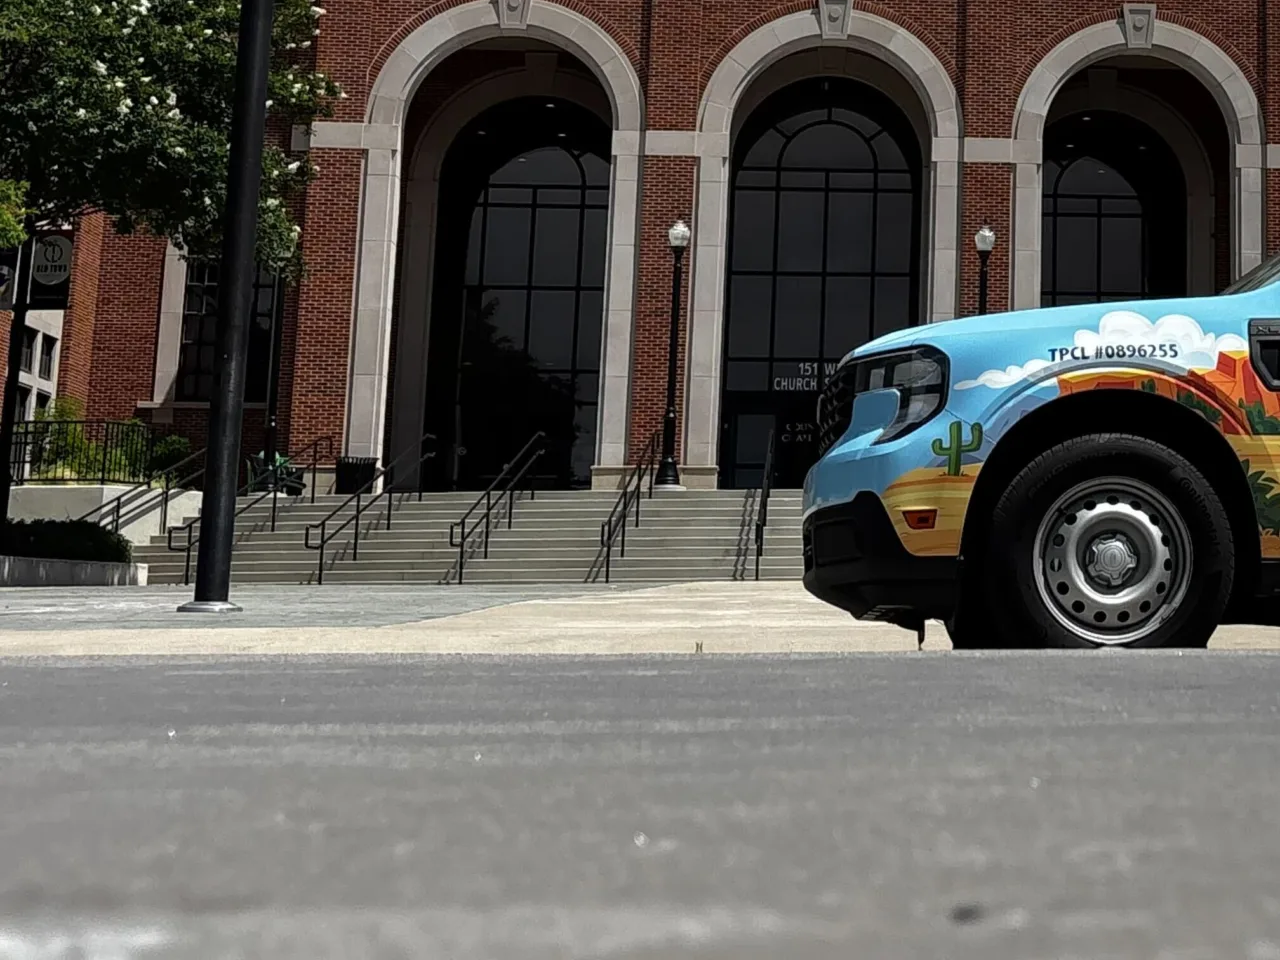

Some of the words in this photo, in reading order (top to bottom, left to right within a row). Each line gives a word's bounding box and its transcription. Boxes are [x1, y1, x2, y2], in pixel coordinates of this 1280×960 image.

[1048, 346, 1090, 362] TPCL
[1095, 343, 1178, 359] #0896255
[798, 362, 818, 375] 151
[774, 377, 818, 391] CHURCH
